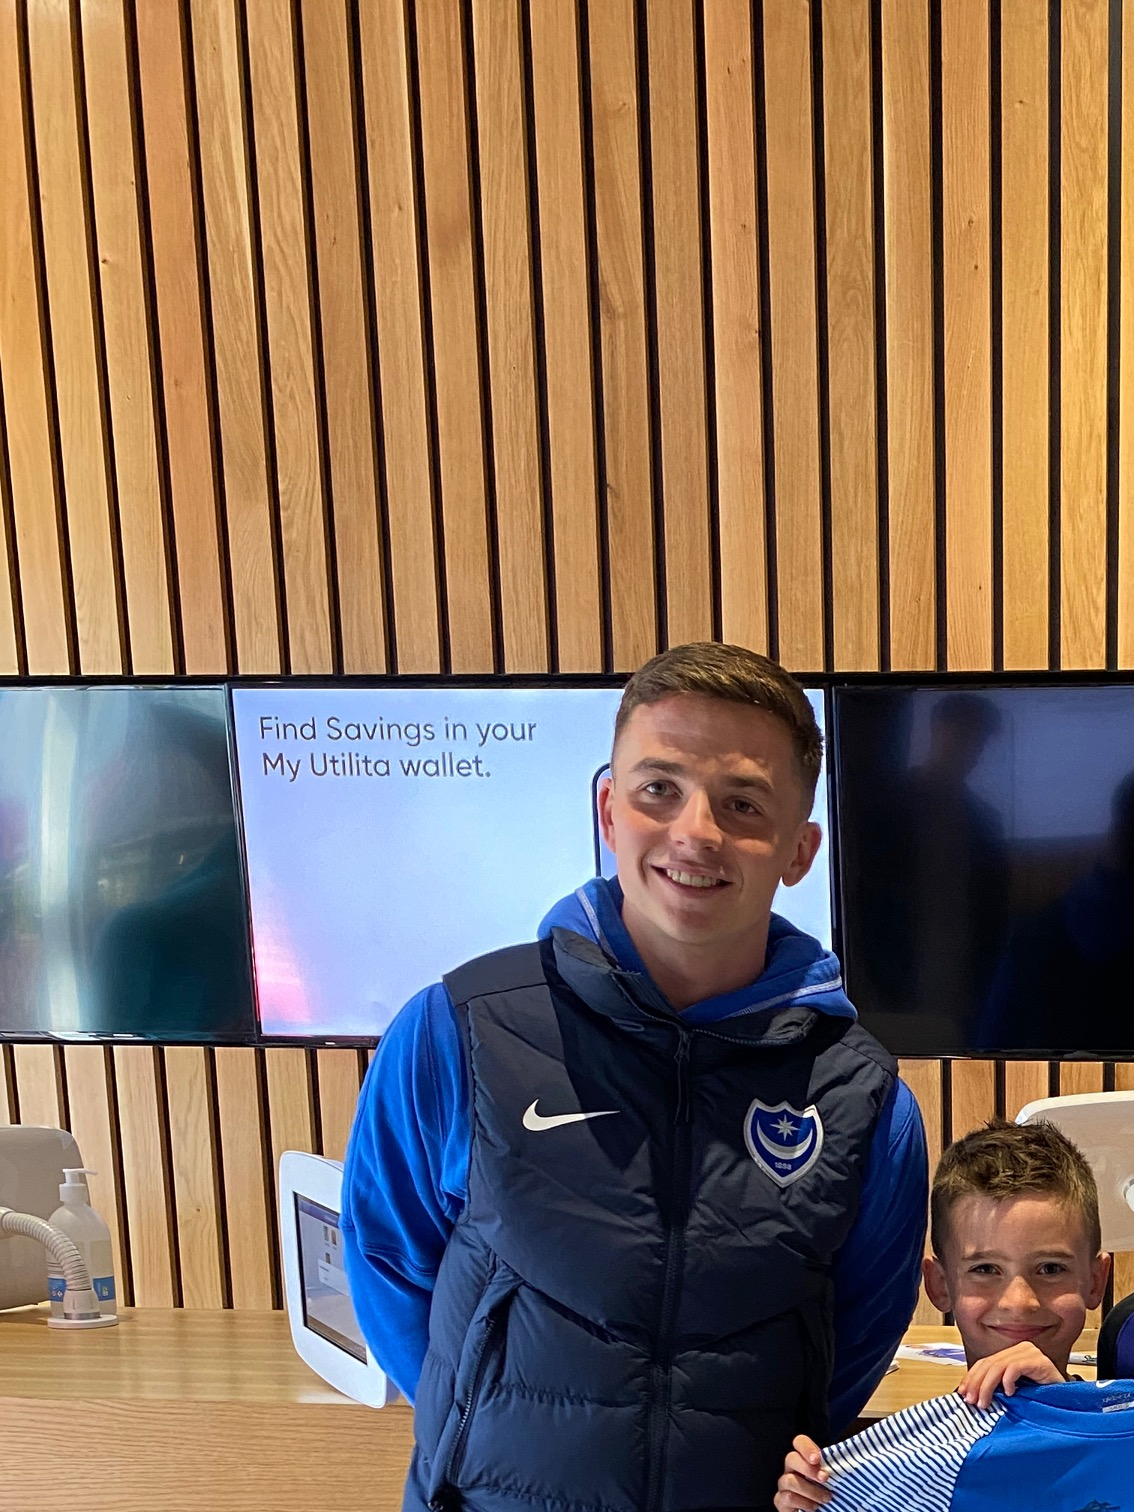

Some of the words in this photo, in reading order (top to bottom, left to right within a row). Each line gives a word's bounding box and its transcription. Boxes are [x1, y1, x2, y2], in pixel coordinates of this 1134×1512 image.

[259, 715, 316, 741] Find
[326, 716, 436, 747] Savings
[445, 716, 468, 741] in
[475, 721, 538, 747] your
[261, 752, 302, 782] My
[309, 752, 391, 777] Utilita
[399, 752, 492, 778] wallet.
